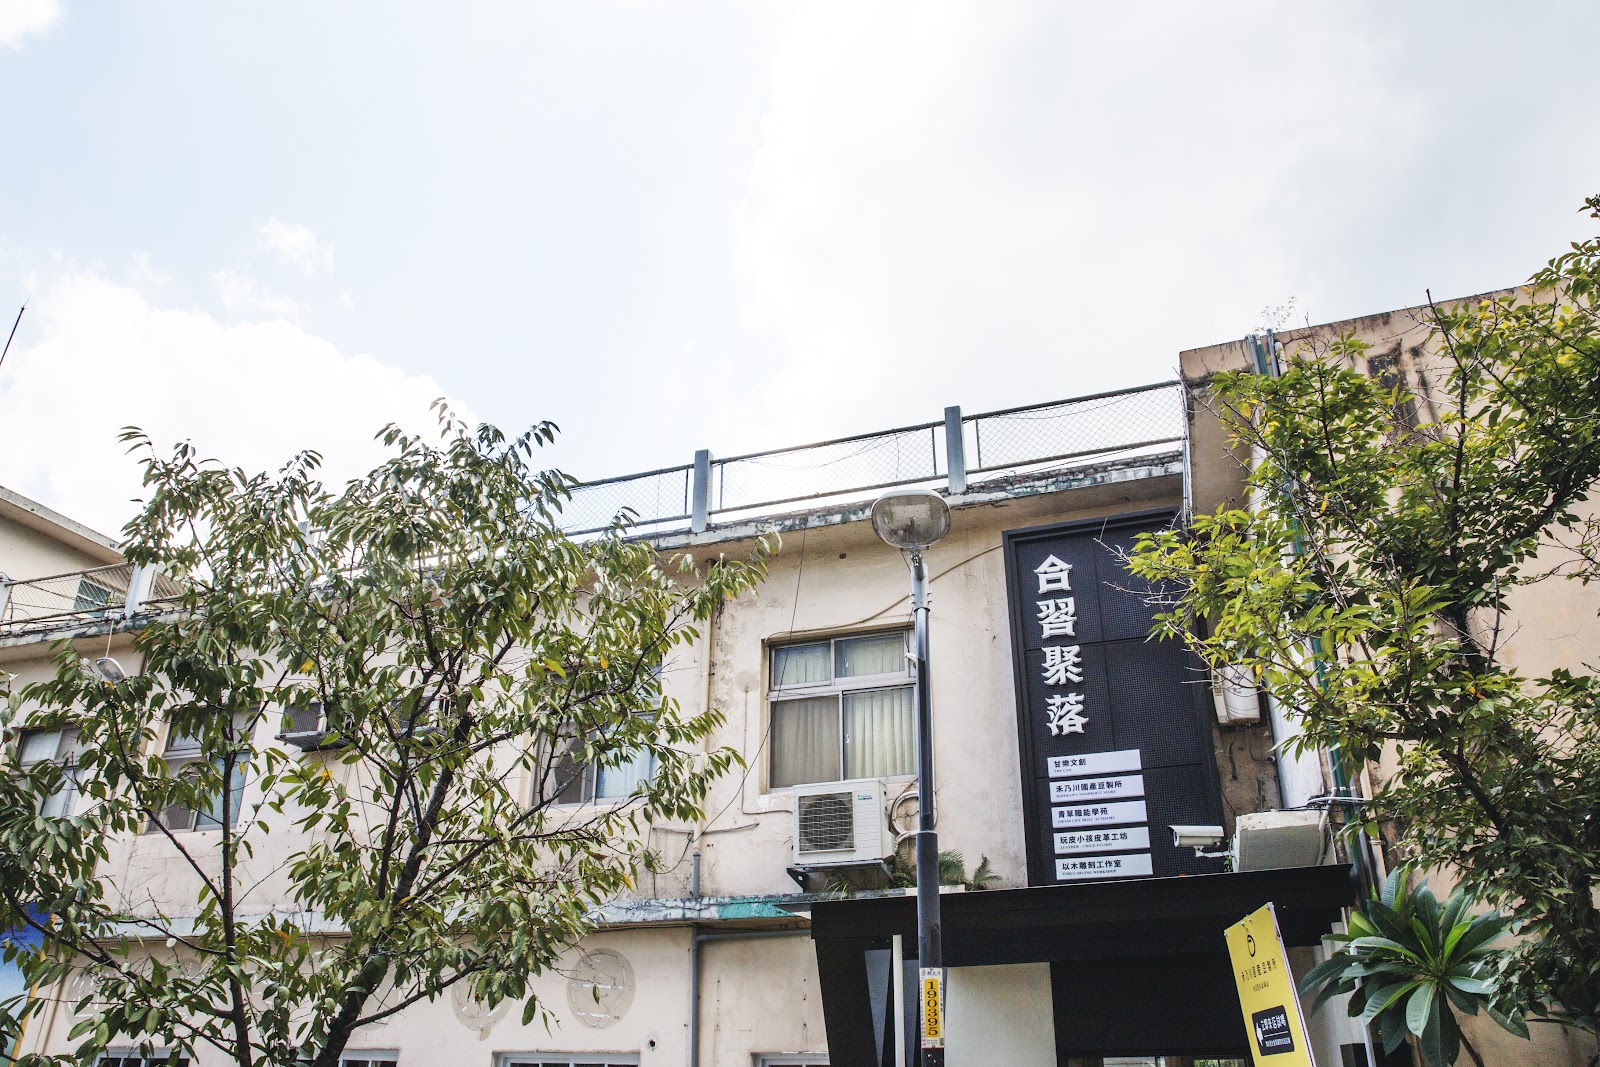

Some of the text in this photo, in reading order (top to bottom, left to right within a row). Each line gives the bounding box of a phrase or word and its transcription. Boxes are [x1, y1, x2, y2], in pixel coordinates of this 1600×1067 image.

[1053, 758, 1087, 768] 甘樂文創
[1056, 780, 1122, 793] 禾乃川國產豆製所
[1058, 807, 1108, 819] 青草職能學苑
[1060, 832, 1128, 845] 玩皮小孩皮革工坊
[1062, 859, 1122, 871] 以木雕刻工作室
[926, 981, 938, 1036] 190395
